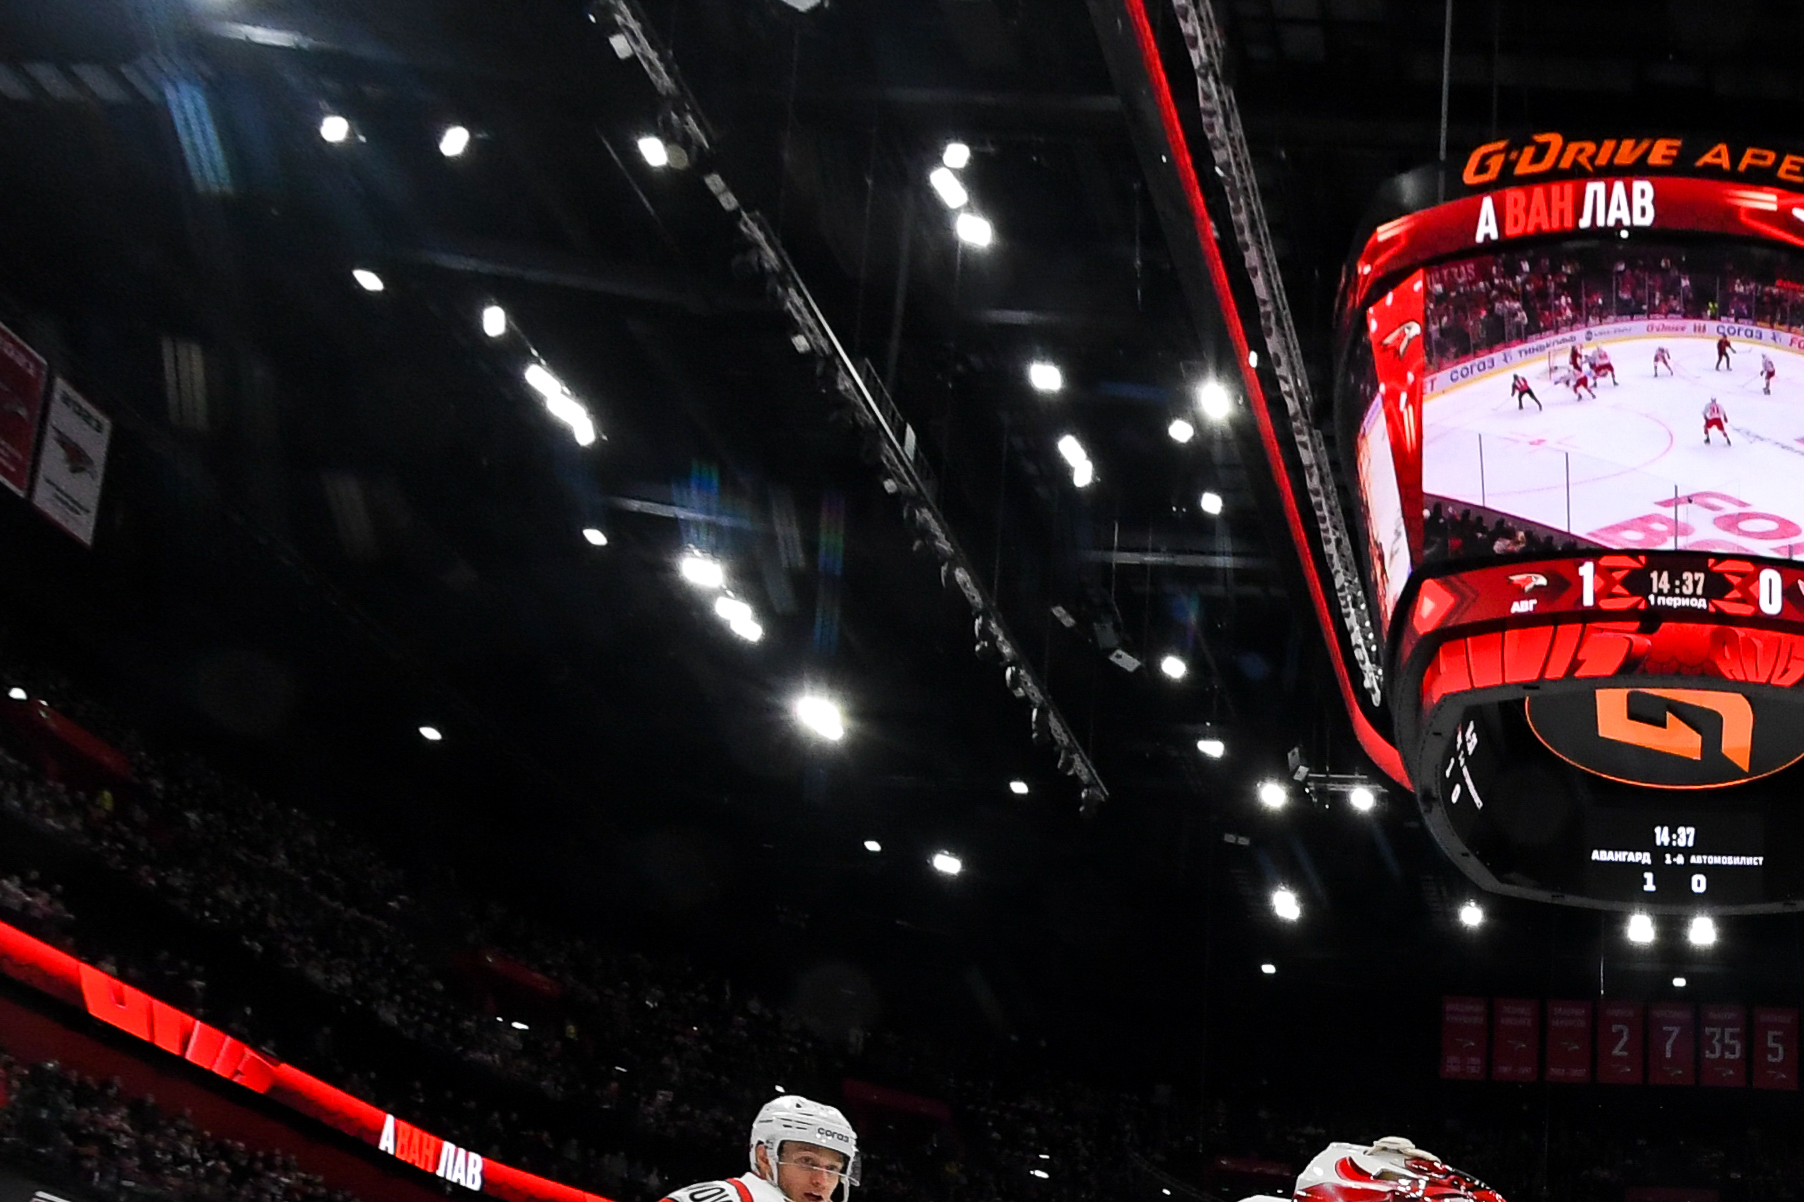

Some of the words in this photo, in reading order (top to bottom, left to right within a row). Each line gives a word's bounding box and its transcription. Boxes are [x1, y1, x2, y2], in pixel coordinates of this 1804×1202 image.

[1475, 196, 1499, 243] А
[1504, 183, 1573, 237] ВАН
[1578, 179, 1656, 229] ЛАВ
[1578, 561, 1595, 607] 1
[1650, 570, 1706, 597] 14:37
[1758, 567, 1783, 616] 0
[1509, 599, 1538, 615] АВГ
[1648, 593, 1656, 606] 1
[1657, 595, 1708, 610] период
[1653, 825, 1696, 847] 14:37
[1591, 849, 1652, 865] АВАНГАРД
[1689, 854, 1765, 866] АВТОМОБИЛИСТ
[1643, 871, 1657, 892] 1
[1690, 873, 1707, 893] 0
[1610, 1023, 1630, 1057] 2
[1661, 1025, 1681, 1059] 7
[1704, 1026, 1742, 1060] 35
[1766, 1030, 1785, 1063] 5
[817, 1127, 850, 1144] согаз
[378, 1113, 395, 1156] А
[395, 1119, 438, 1173] ВАН
[436, 1140, 483, 1192] ЛАВ
